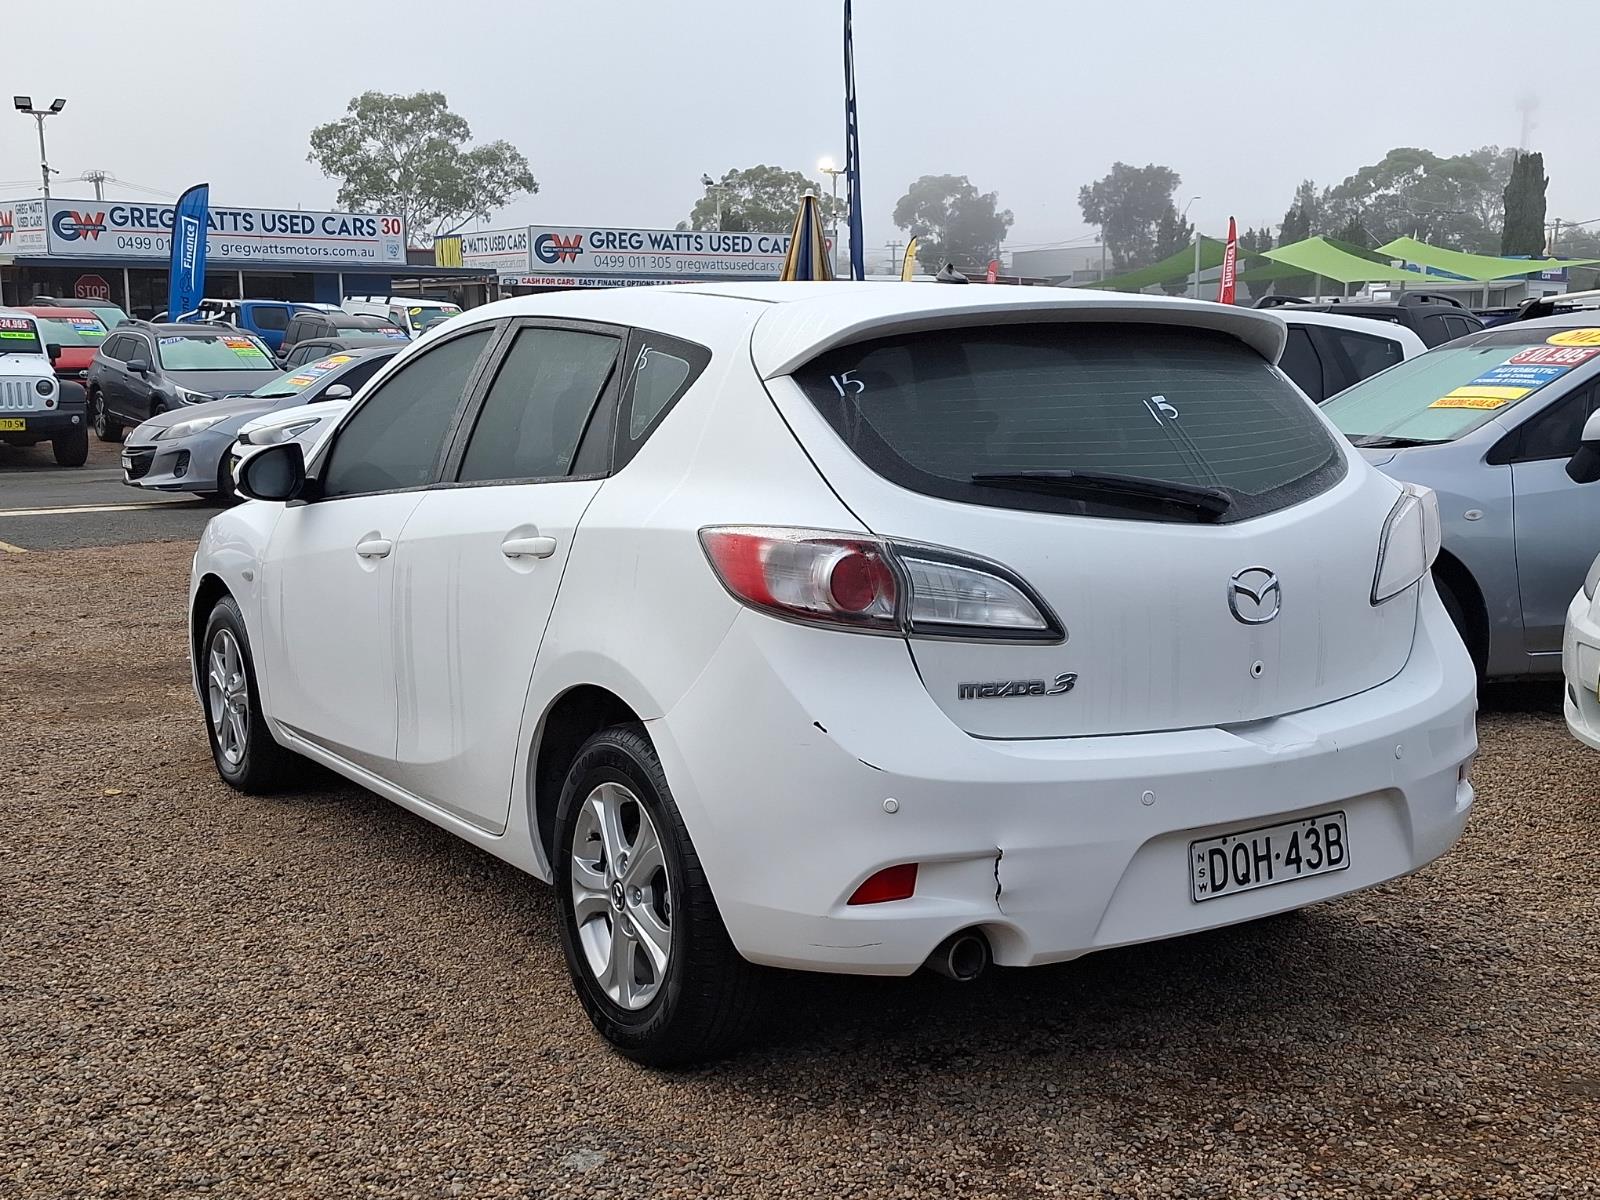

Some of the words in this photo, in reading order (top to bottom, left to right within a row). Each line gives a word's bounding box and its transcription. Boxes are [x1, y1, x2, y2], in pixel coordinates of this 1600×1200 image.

[15, 204, 28, 215] GREG
[29, 202, 43, 213] WATTS
[17, 217, 29, 228] USED
[30, 216, 42, 227] CARS
[109, 206, 175, 229] GREG
[207, 211, 254, 232] ATTS
[261, 213, 315, 235] USED
[321, 216, 377, 237] CARS
[381, 218, 401, 235] 30
[117, 236, 151, 250] 0499
[156, 238, 171, 251] 01
[221, 243, 375, 258] gregwattsmotors.com.au
[183, 224, 195, 269] Finance
[468, 237, 488, 253] WATTS
[489, 235, 506, 252] USED
[507, 233, 527, 250] CARS
[589, 231, 644, 250] GREG
[647, 233, 704, 252] WATTS
[709, 235, 753, 253] USED
[758, 237, 792, 254] CAR
[593, 255, 625, 268] 0499
[628, 255, 646, 269] 011
[650, 256, 672, 269] 305
[676, 259, 783, 272] gregwattsusedcars.c
[77, 285, 107, 298] STOP
[830, 369, 865, 397] 15
[1142, 395, 1179, 427] 15
[1046, 671, 1078, 696] 3
